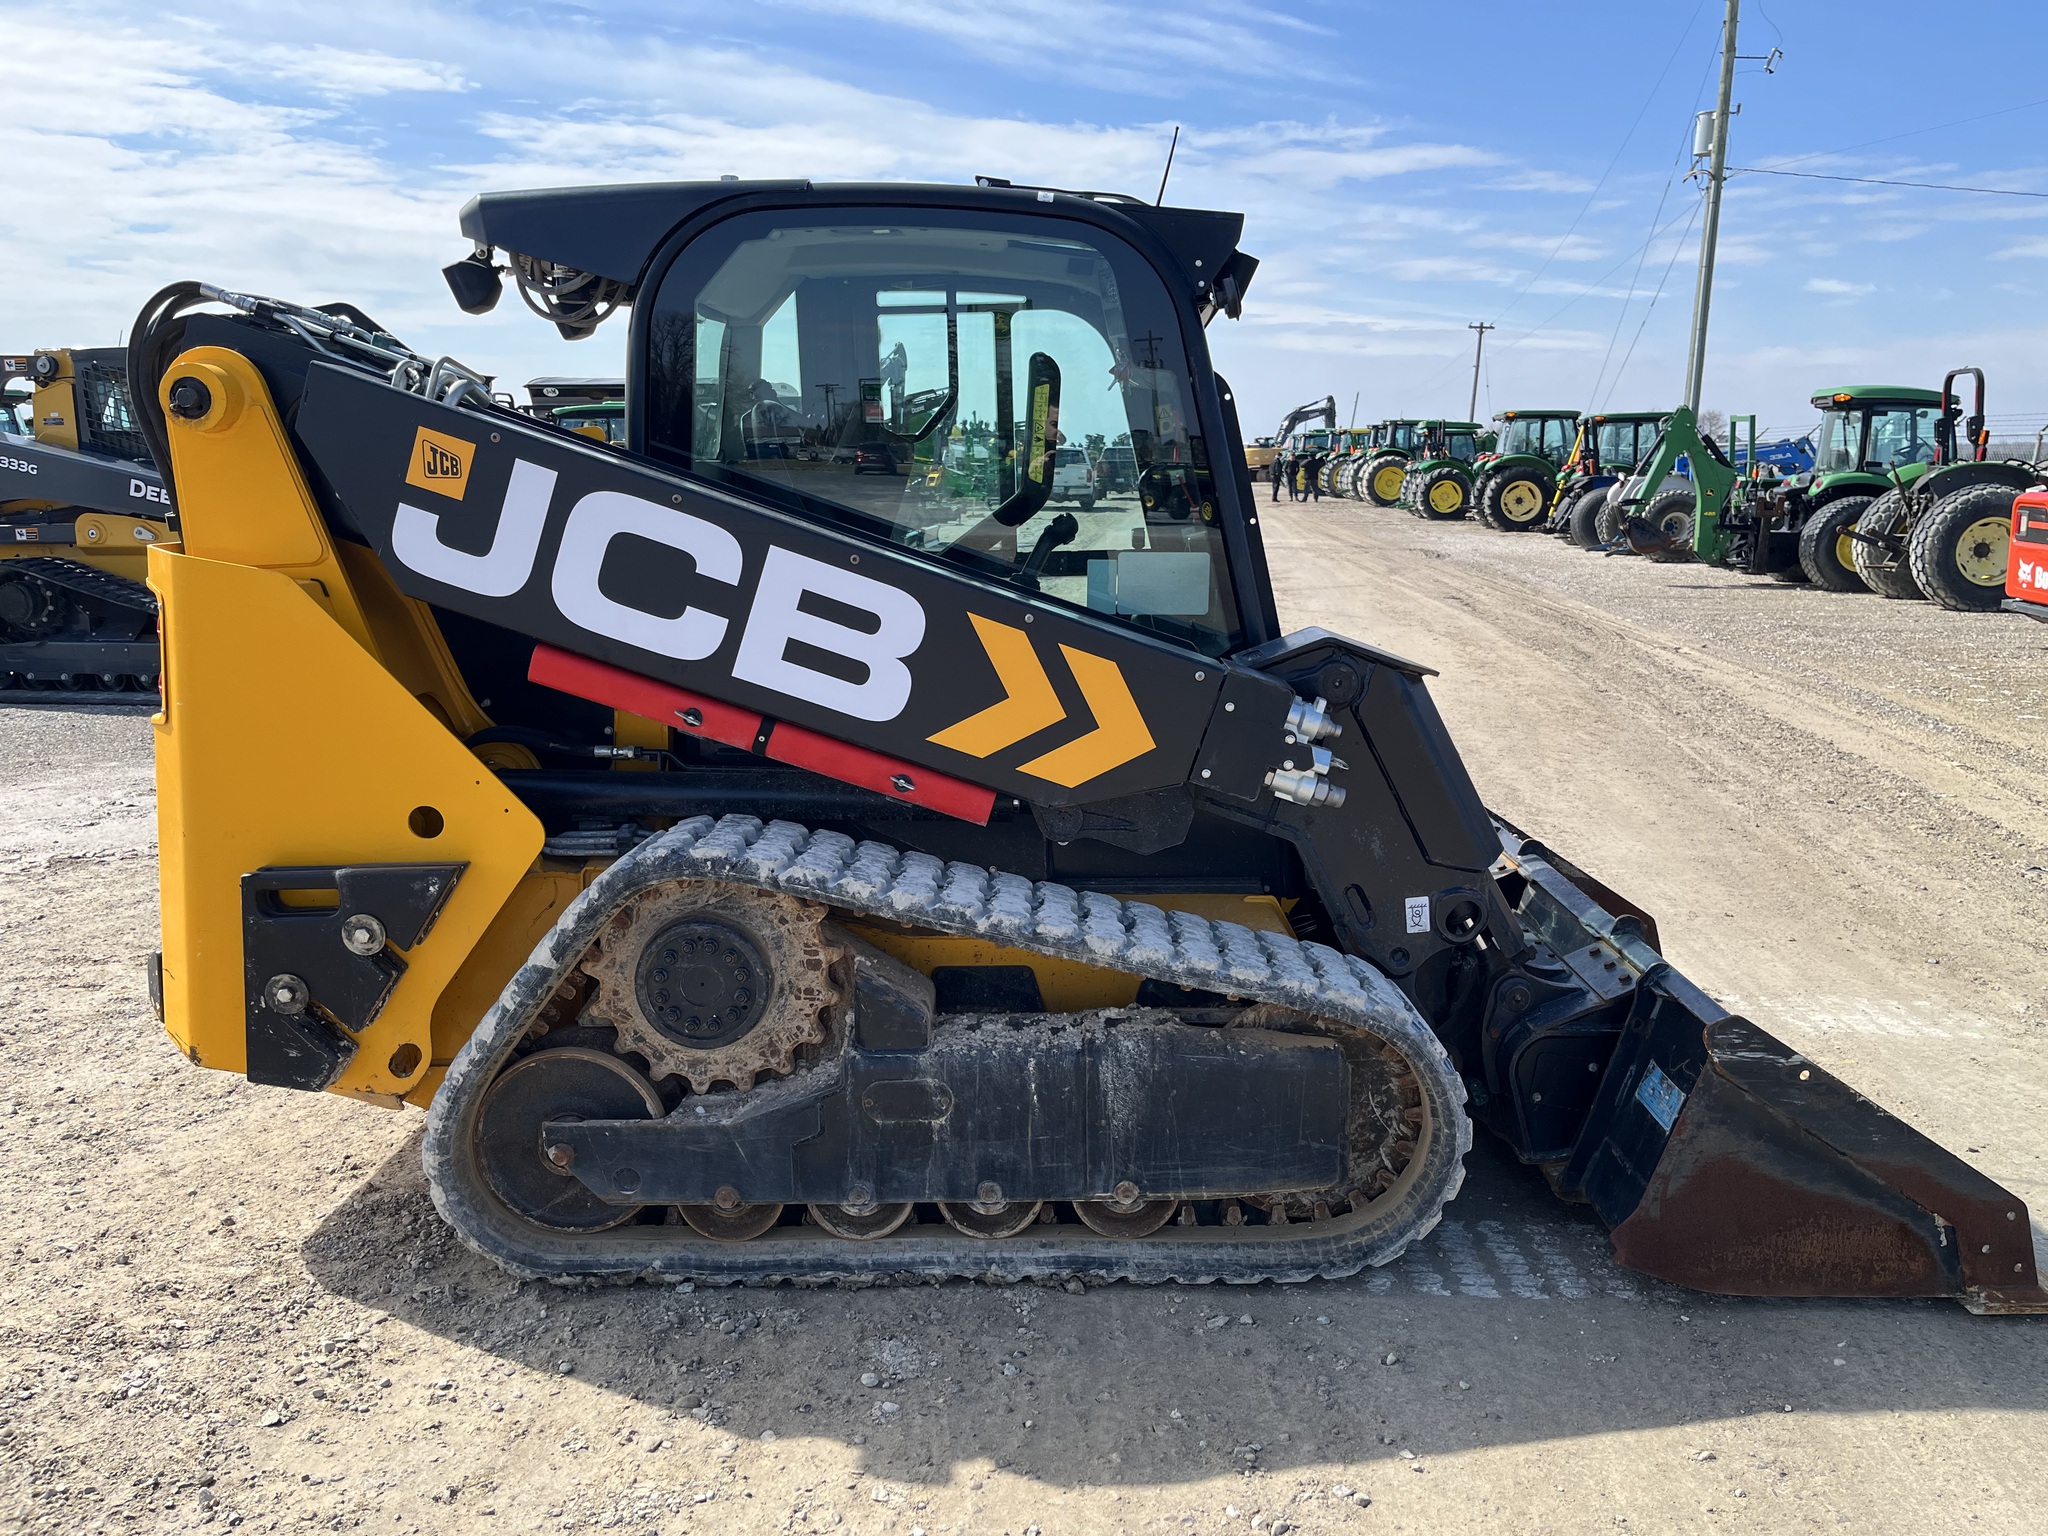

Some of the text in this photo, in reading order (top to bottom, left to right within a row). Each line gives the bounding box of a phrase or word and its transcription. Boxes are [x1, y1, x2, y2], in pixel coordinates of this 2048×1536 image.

[0, 456, 38, 475] 333G
[427, 446, 459, 476] JCB
[391, 457, 927, 723] JCB
